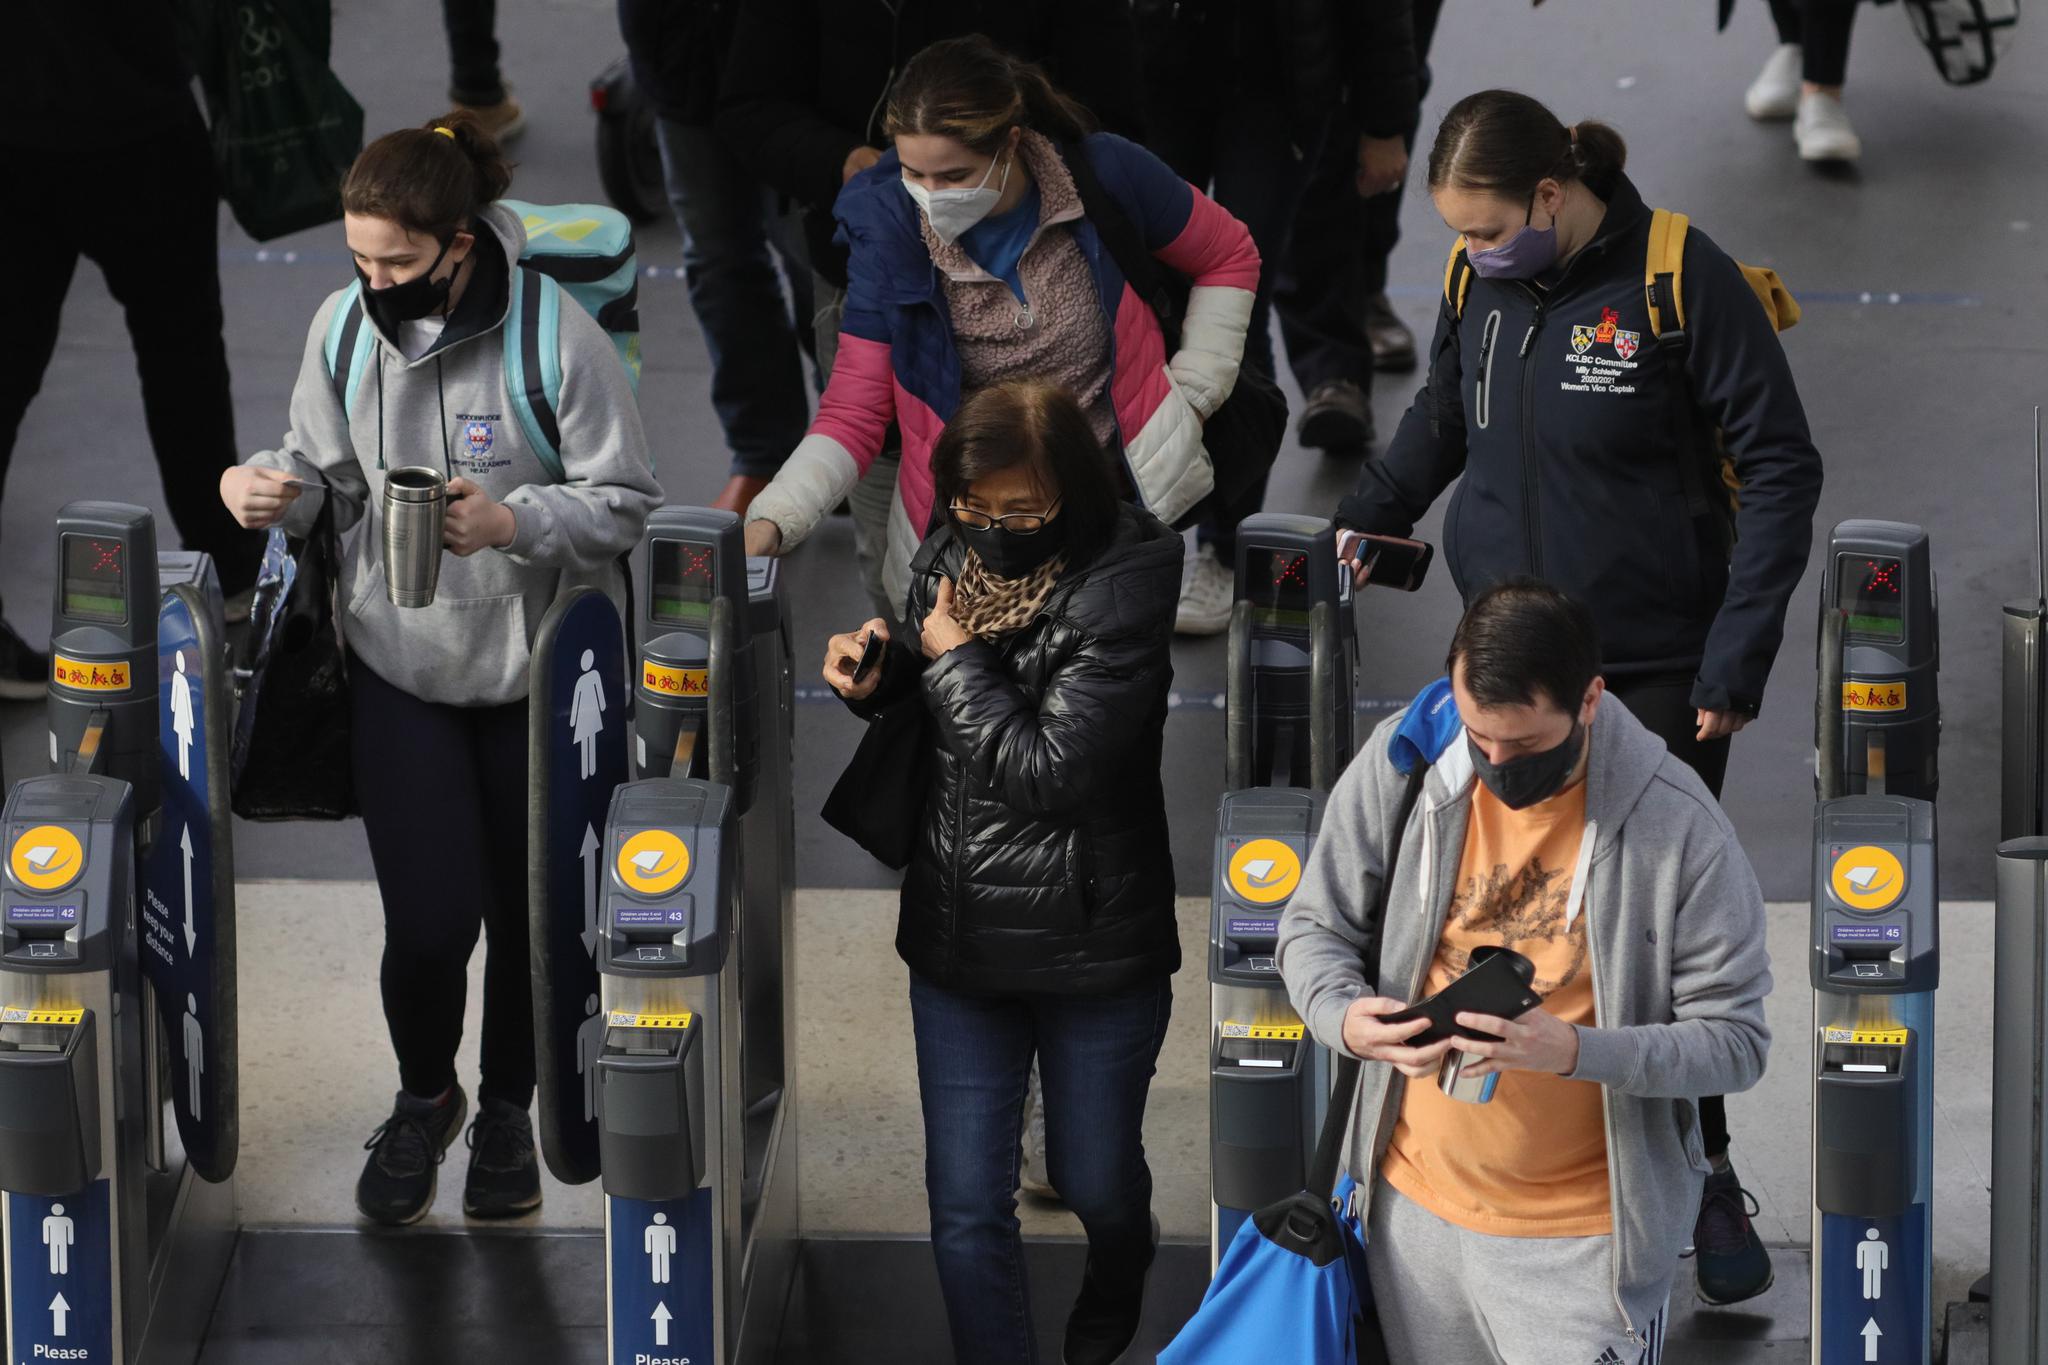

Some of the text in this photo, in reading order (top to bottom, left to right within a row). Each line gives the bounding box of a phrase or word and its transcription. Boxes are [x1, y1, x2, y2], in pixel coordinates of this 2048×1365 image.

[1565, 353, 1638, 368] KCLBC Committee
[1581, 375, 1615, 384] 2020/2021
[1561, 382, 1635, 394] Women's Vice Captain
[148, 888, 169, 919] Please
[61, 909, 75, 918] 42
[669, 912, 682, 921] 43
[143, 905, 174, 944] keep your
[1886, 929, 1900, 938] 45
[145, 931, 173, 966] distance
[34, 1343, 88, 1359] Please
[635, 1354, 690, 1365] Please
